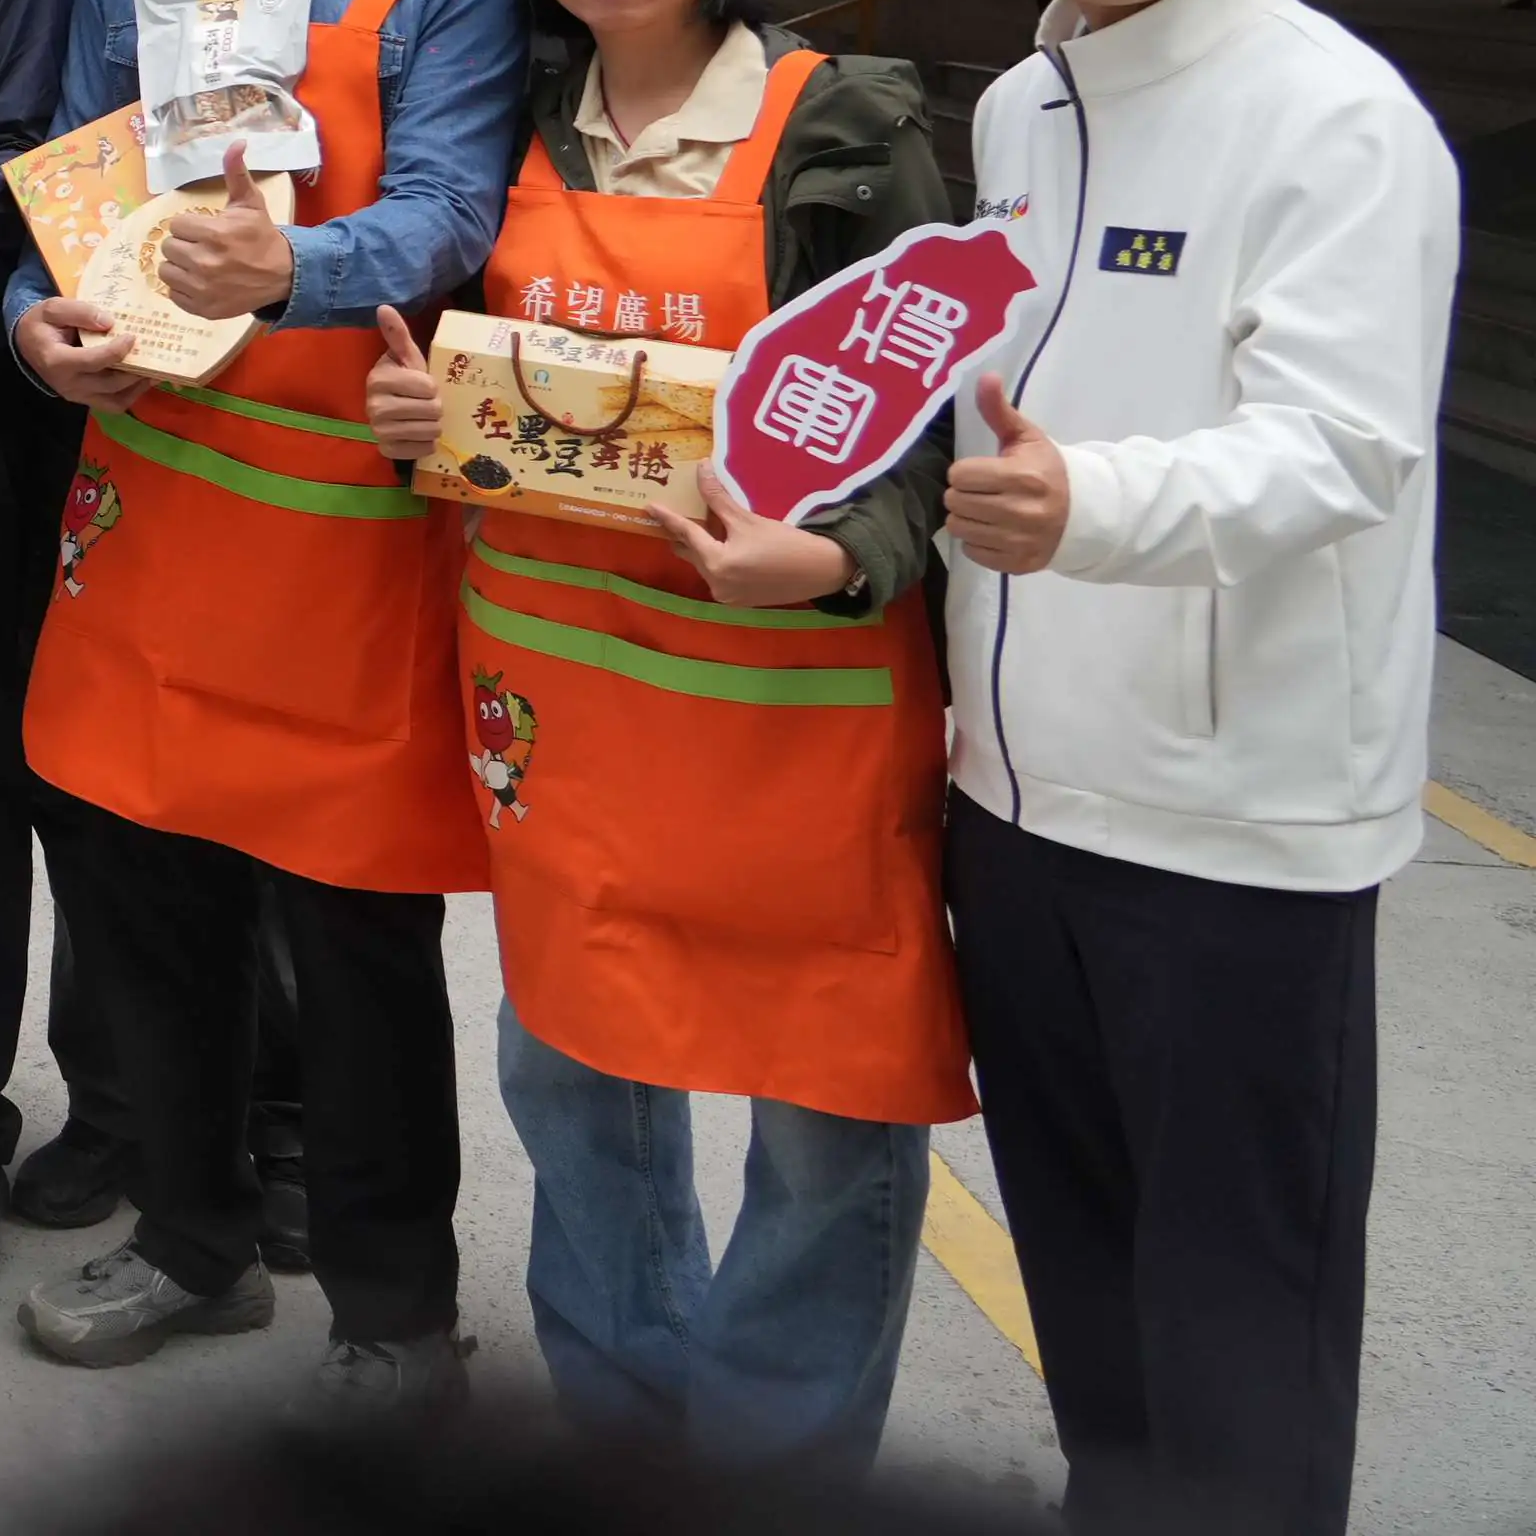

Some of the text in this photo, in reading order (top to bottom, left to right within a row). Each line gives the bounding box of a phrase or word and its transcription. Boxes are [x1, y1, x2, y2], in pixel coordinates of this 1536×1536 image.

[519, 276, 707, 343] 希望廣場
[471, 397, 675, 487] 手工黑豆蛋捲
